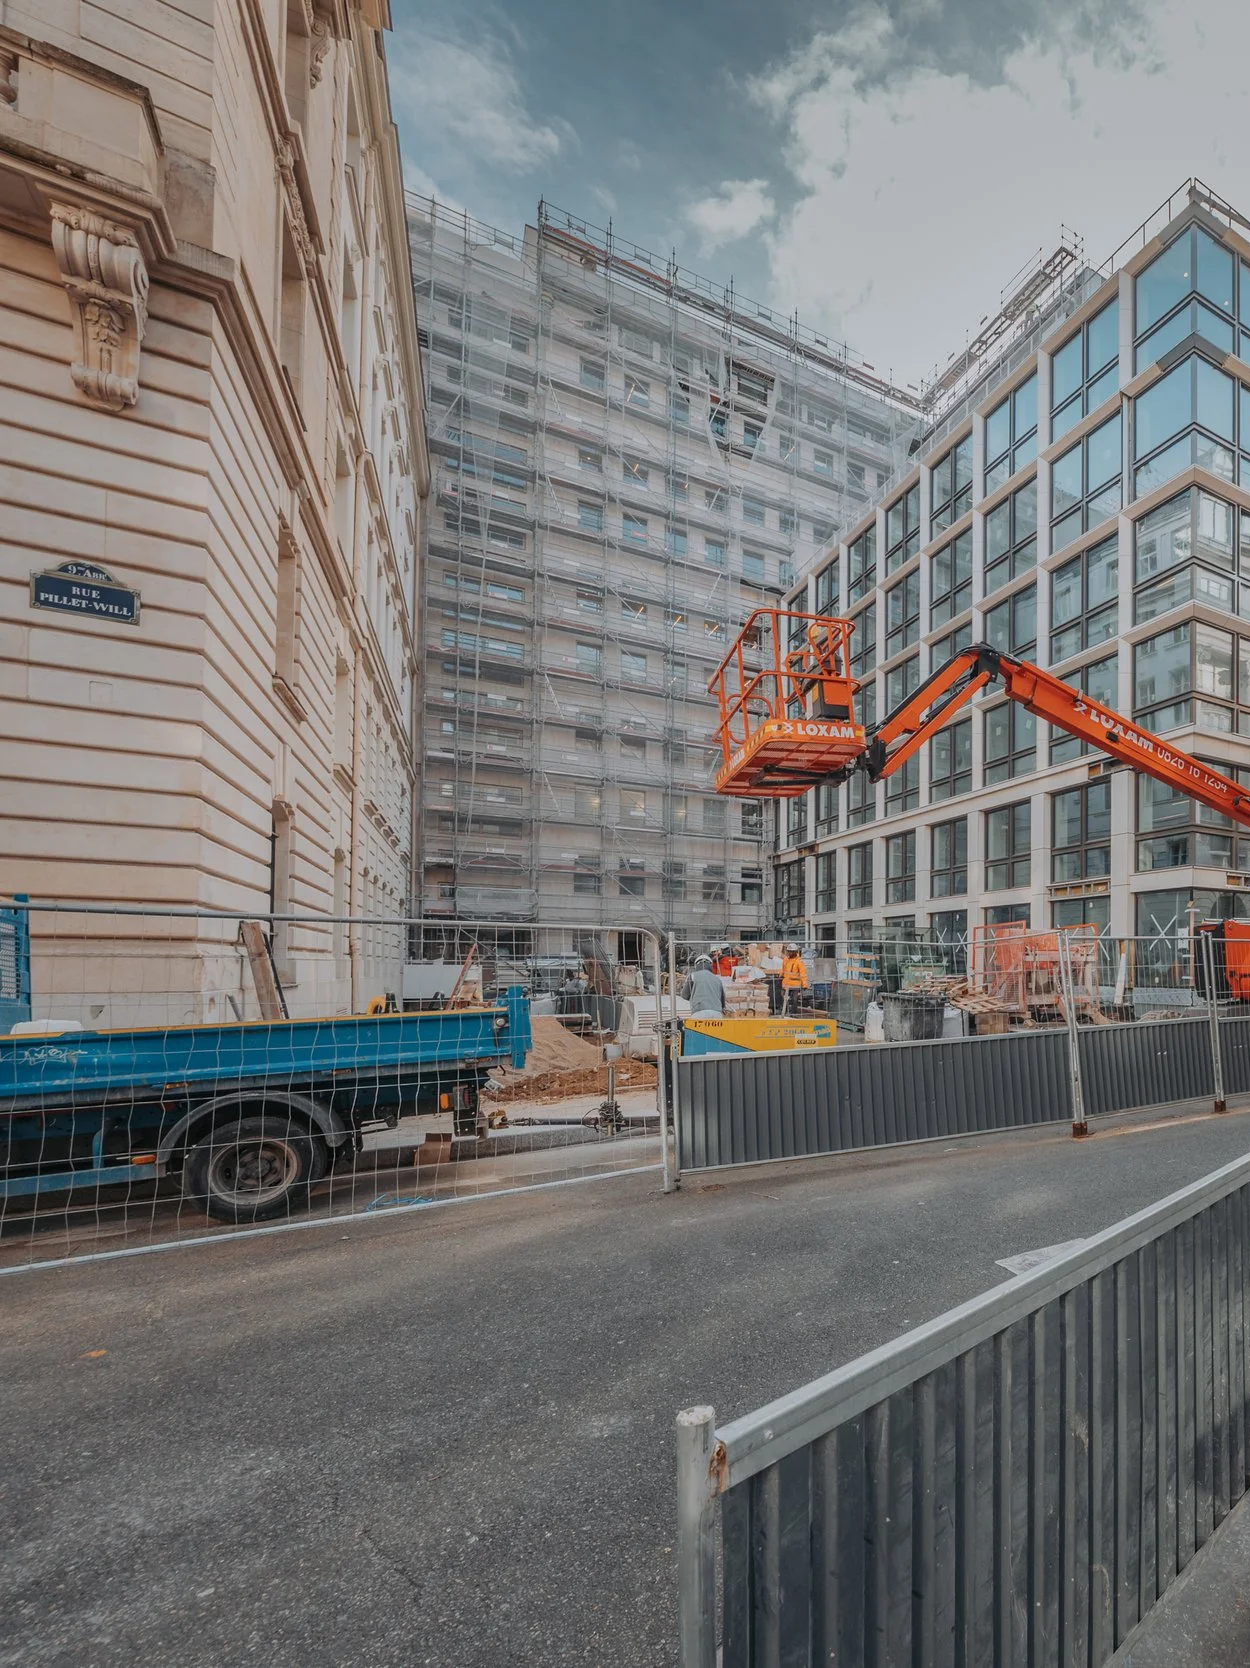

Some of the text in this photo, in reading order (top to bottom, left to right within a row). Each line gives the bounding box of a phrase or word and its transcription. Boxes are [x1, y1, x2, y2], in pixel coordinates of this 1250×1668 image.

[72, 587, 100, 599] RUE
[40, 593, 131, 615] PILLET-WILL
[797, 723, 855, 739] LOXAM
[1090, 709, 1154, 752] LOXAM
